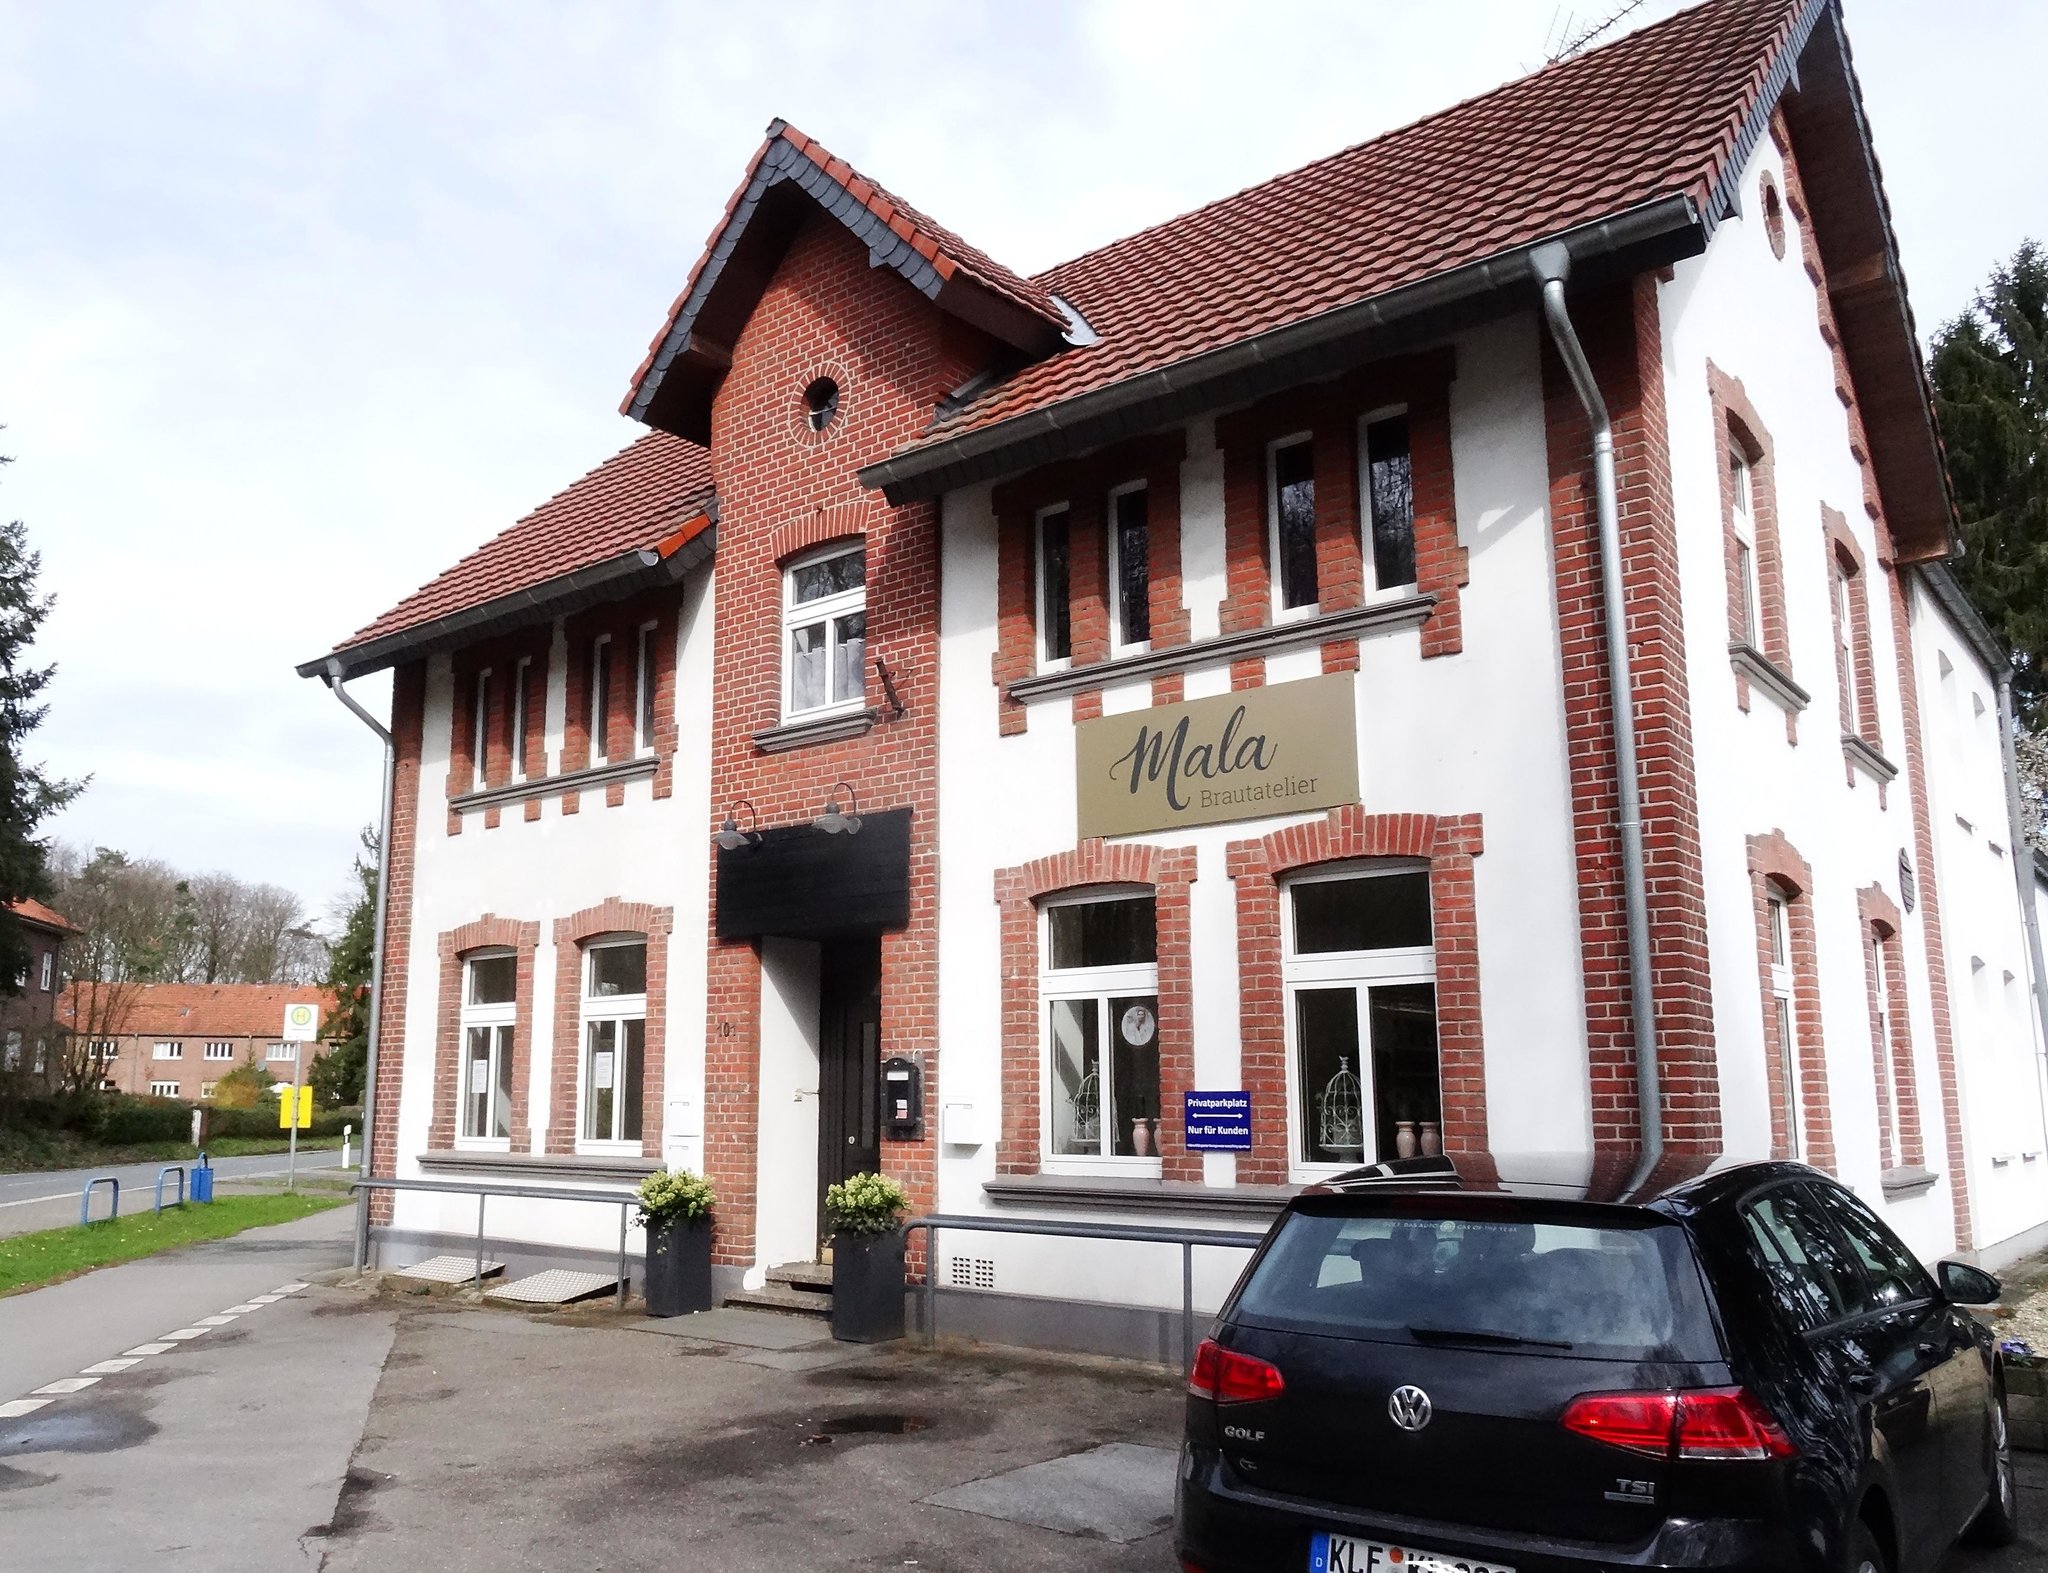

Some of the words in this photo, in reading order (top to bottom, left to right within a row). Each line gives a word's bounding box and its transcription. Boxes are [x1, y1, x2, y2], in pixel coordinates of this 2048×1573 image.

[1109, 705, 1278, 811] Mala
[1201, 776, 1318, 808] Brautatelier
[1187, 1098, 1248, 1109] Privatparkplatz
[1187, 1125, 1203, 1135] Nur
[1204, 1125, 1216, 1135] für
[1217, 1126, 1249, 1136] Kunden
[1224, 1425, 1265, 1442] GOLF
[1616, 1478, 1656, 1495] TSI
[1315, 1556, 1323, 1568] D
